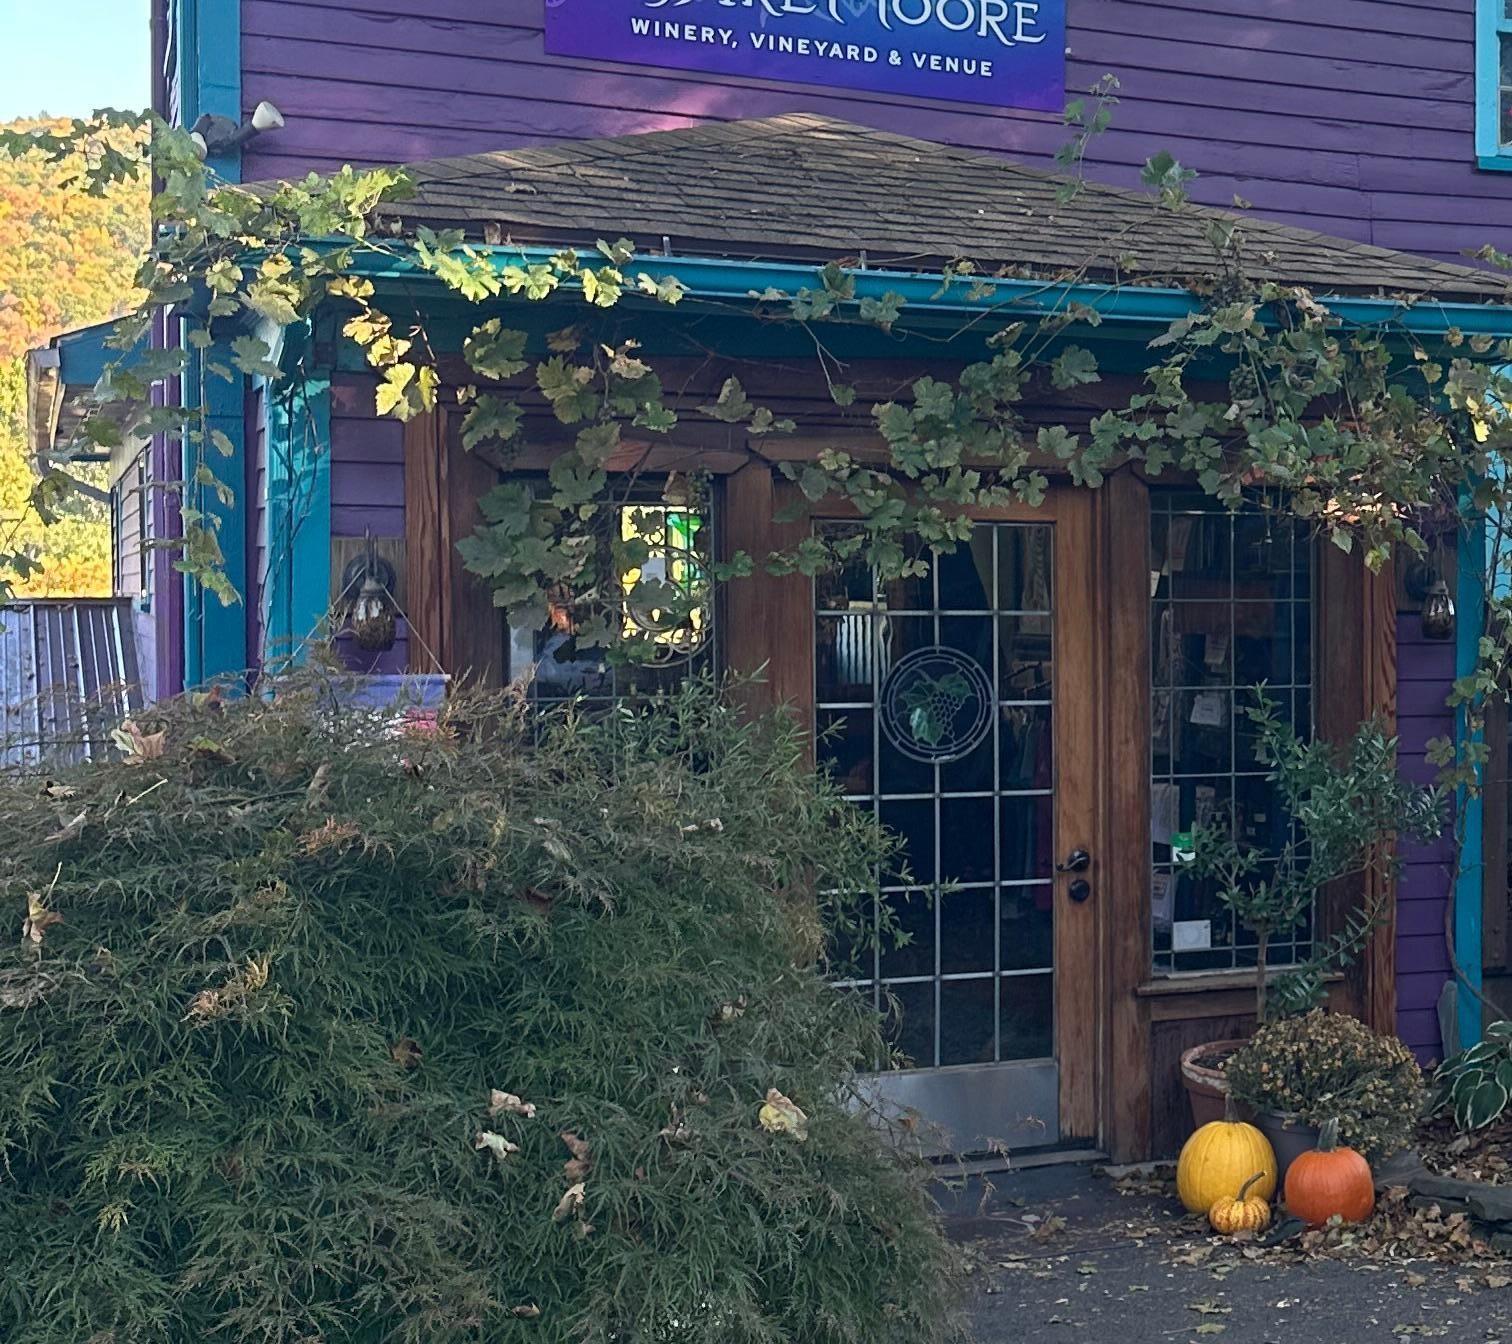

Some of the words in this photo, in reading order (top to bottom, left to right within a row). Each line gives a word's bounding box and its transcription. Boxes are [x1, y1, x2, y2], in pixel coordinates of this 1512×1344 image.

[631, 18, 739, 49] WINERY,
[749, 31, 878, 64] VINEYARD
[889, 50, 902, 66] &
[912, 53, 993, 77] VENUE
